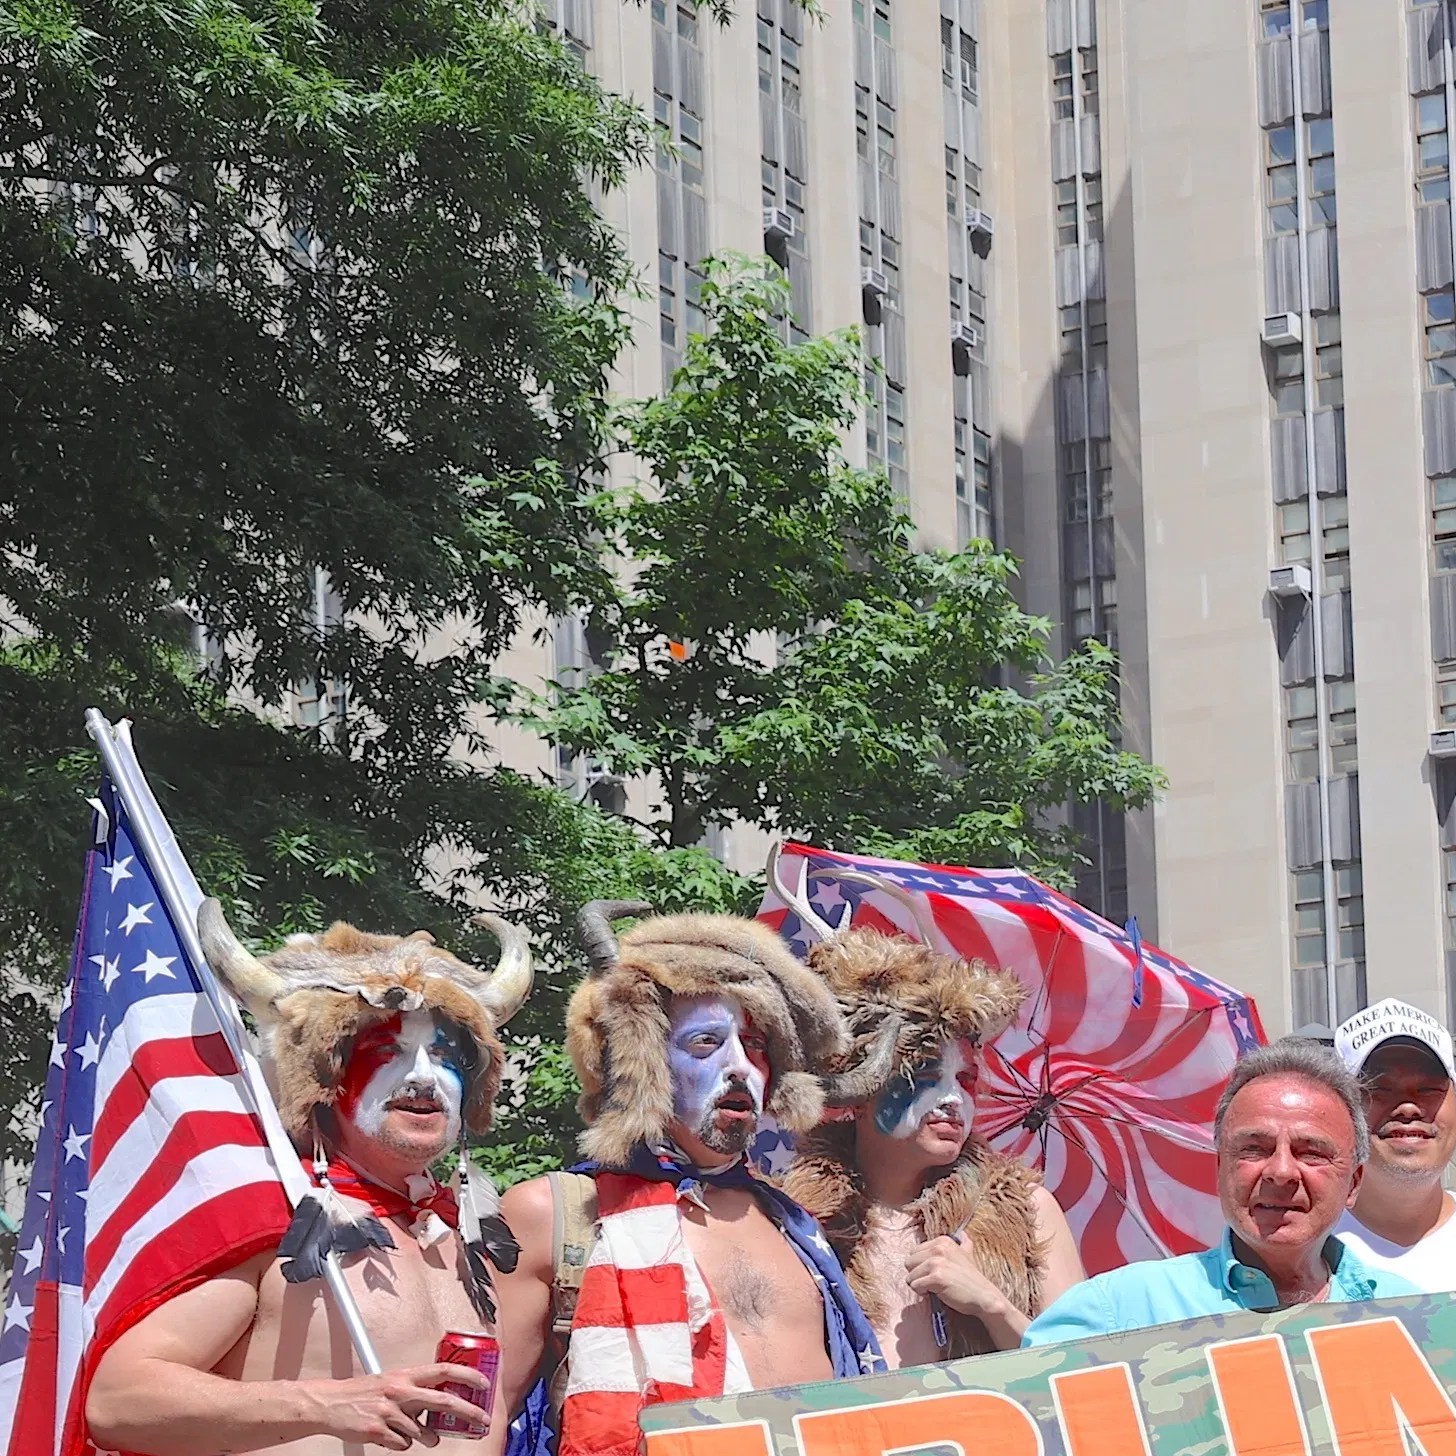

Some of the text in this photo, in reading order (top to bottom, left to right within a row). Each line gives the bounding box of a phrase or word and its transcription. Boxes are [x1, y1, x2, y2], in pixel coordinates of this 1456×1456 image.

[1342, 1004, 1446, 1037] MAKE AMERICA
[1352, 1021, 1441, 1050] GREAT AGAIN
